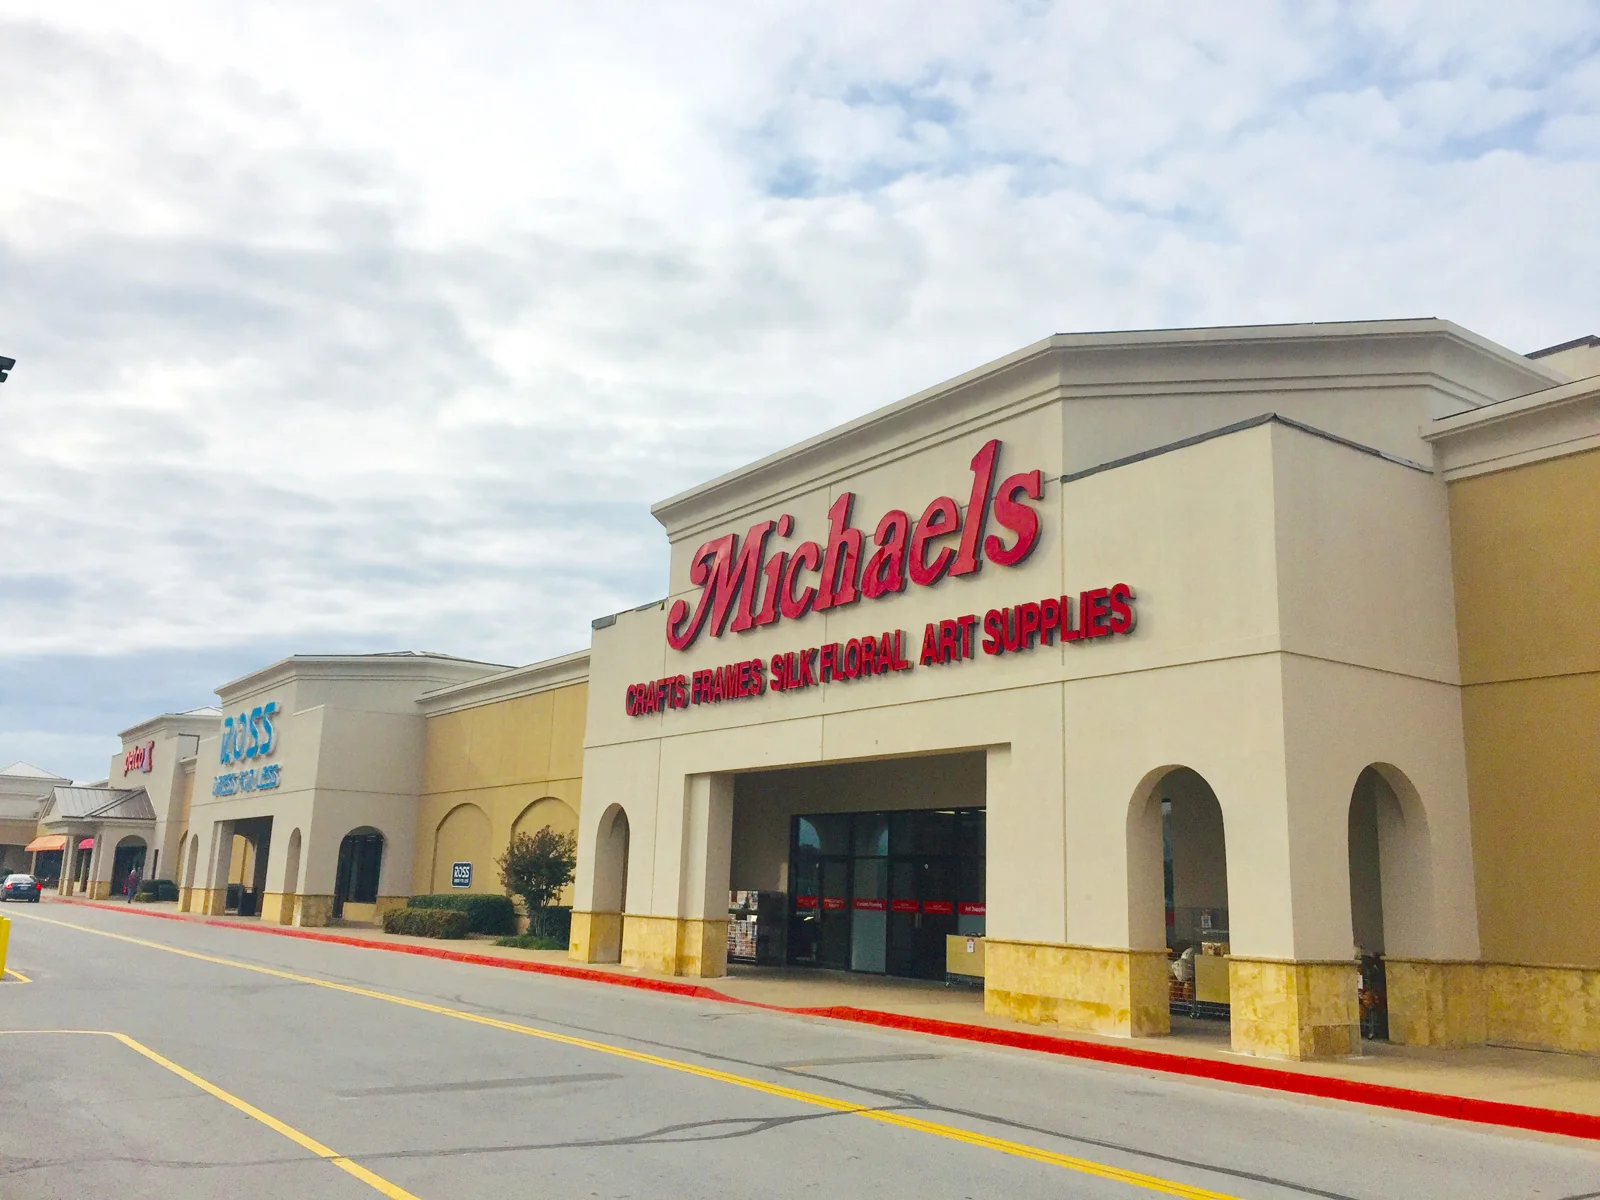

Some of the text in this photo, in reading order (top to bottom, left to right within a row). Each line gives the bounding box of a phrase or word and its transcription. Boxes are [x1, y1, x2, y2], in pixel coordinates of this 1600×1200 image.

[666, 439, 1045, 652] Michaels
[625, 583, 1136, 716] CRAFTS FRAMES SILK FLORAL ART SUPPLIES
[220, 701, 279, 765] ROSS
[454, 866, 470, 878] ROSS
